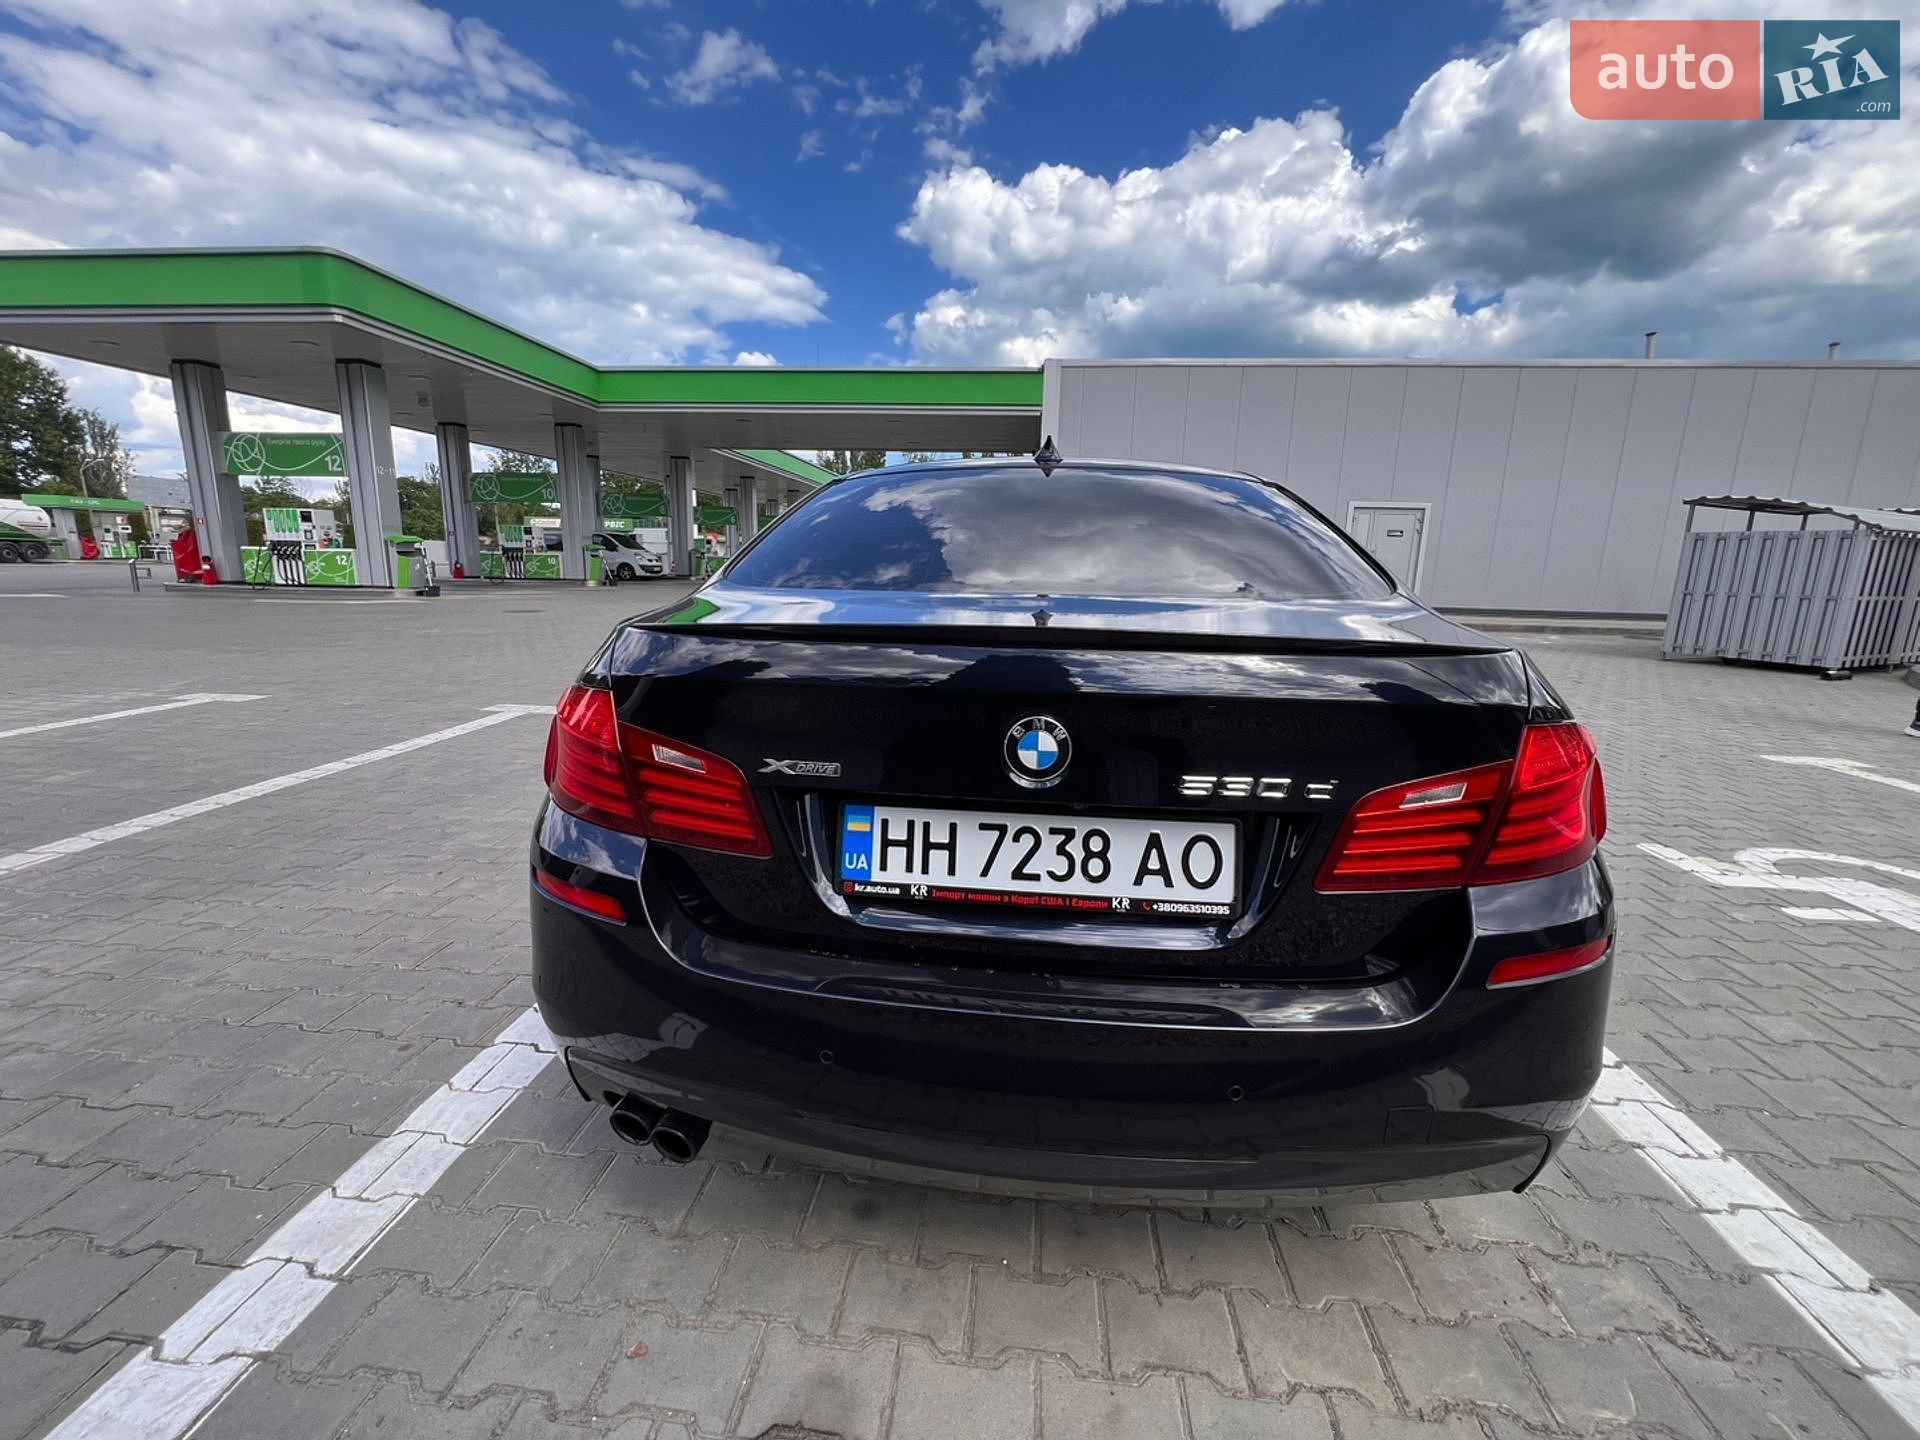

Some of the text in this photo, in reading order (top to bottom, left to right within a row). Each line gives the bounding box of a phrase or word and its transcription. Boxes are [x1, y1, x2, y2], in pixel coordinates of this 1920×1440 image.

[325, 455, 343, 471] 12
[542, 487, 554, 500] 10
[603, 521, 625, 529] РВІС
[335, 554, 348, 566] 12
[547, 557, 556, 565] 10
[1012, 718, 1068, 741] BMW
[878, 818, 1224, 890] HH 7238 AO
[845, 852, 869, 872] UA
[854, 882, 901, 895] kr.auto.ua
[910, 884, 928, 897] KR
[1111, 897, 1131, 910] KR
